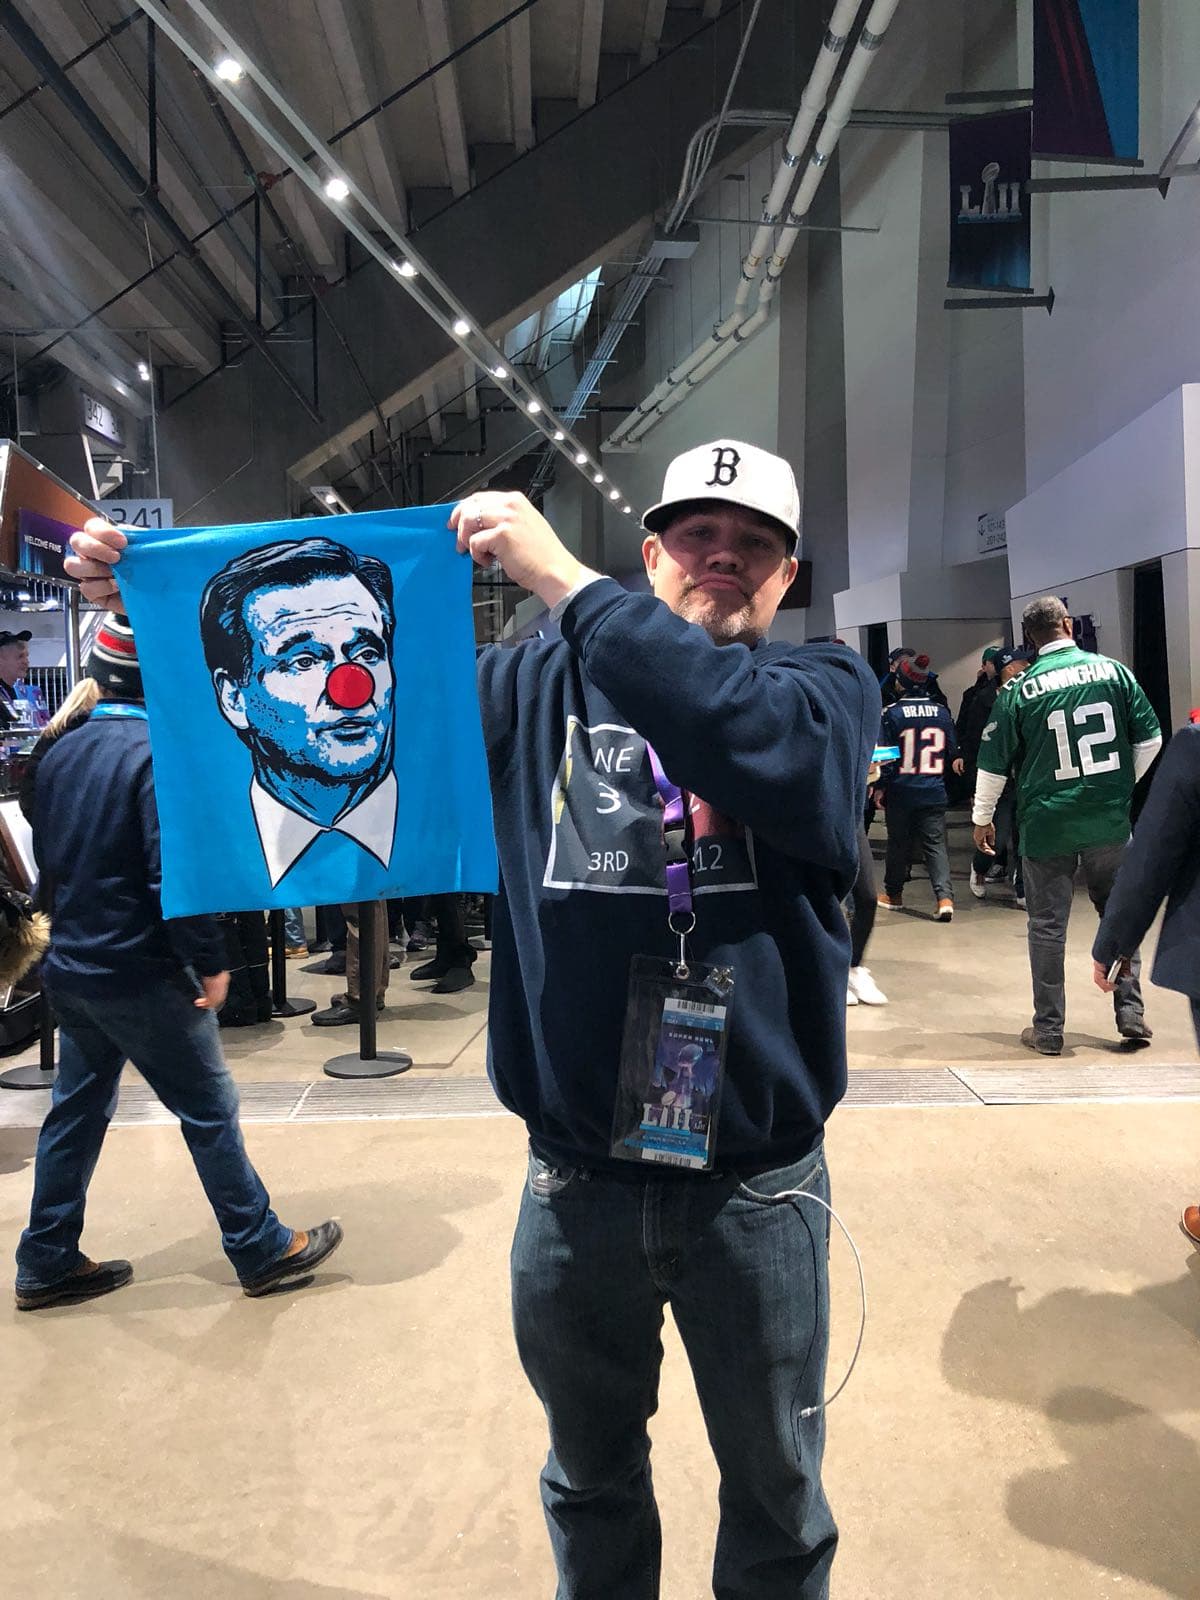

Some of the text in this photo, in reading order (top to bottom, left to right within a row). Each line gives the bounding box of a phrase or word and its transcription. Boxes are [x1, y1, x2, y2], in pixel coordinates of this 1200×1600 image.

[705, 447, 741, 486] B
[24, 534, 62, 554] WELCOME FANS
[1022, 662, 1119, 700] CUNNINGHAM
[902, 705, 939, 718] BRADY
[899, 726, 945, 774] 12
[1047, 701, 1121, 781] 12
[594, 747, 634, 773] NE
[596, 781, 622, 814] 3
[587, 851, 629, 872] 3RD
